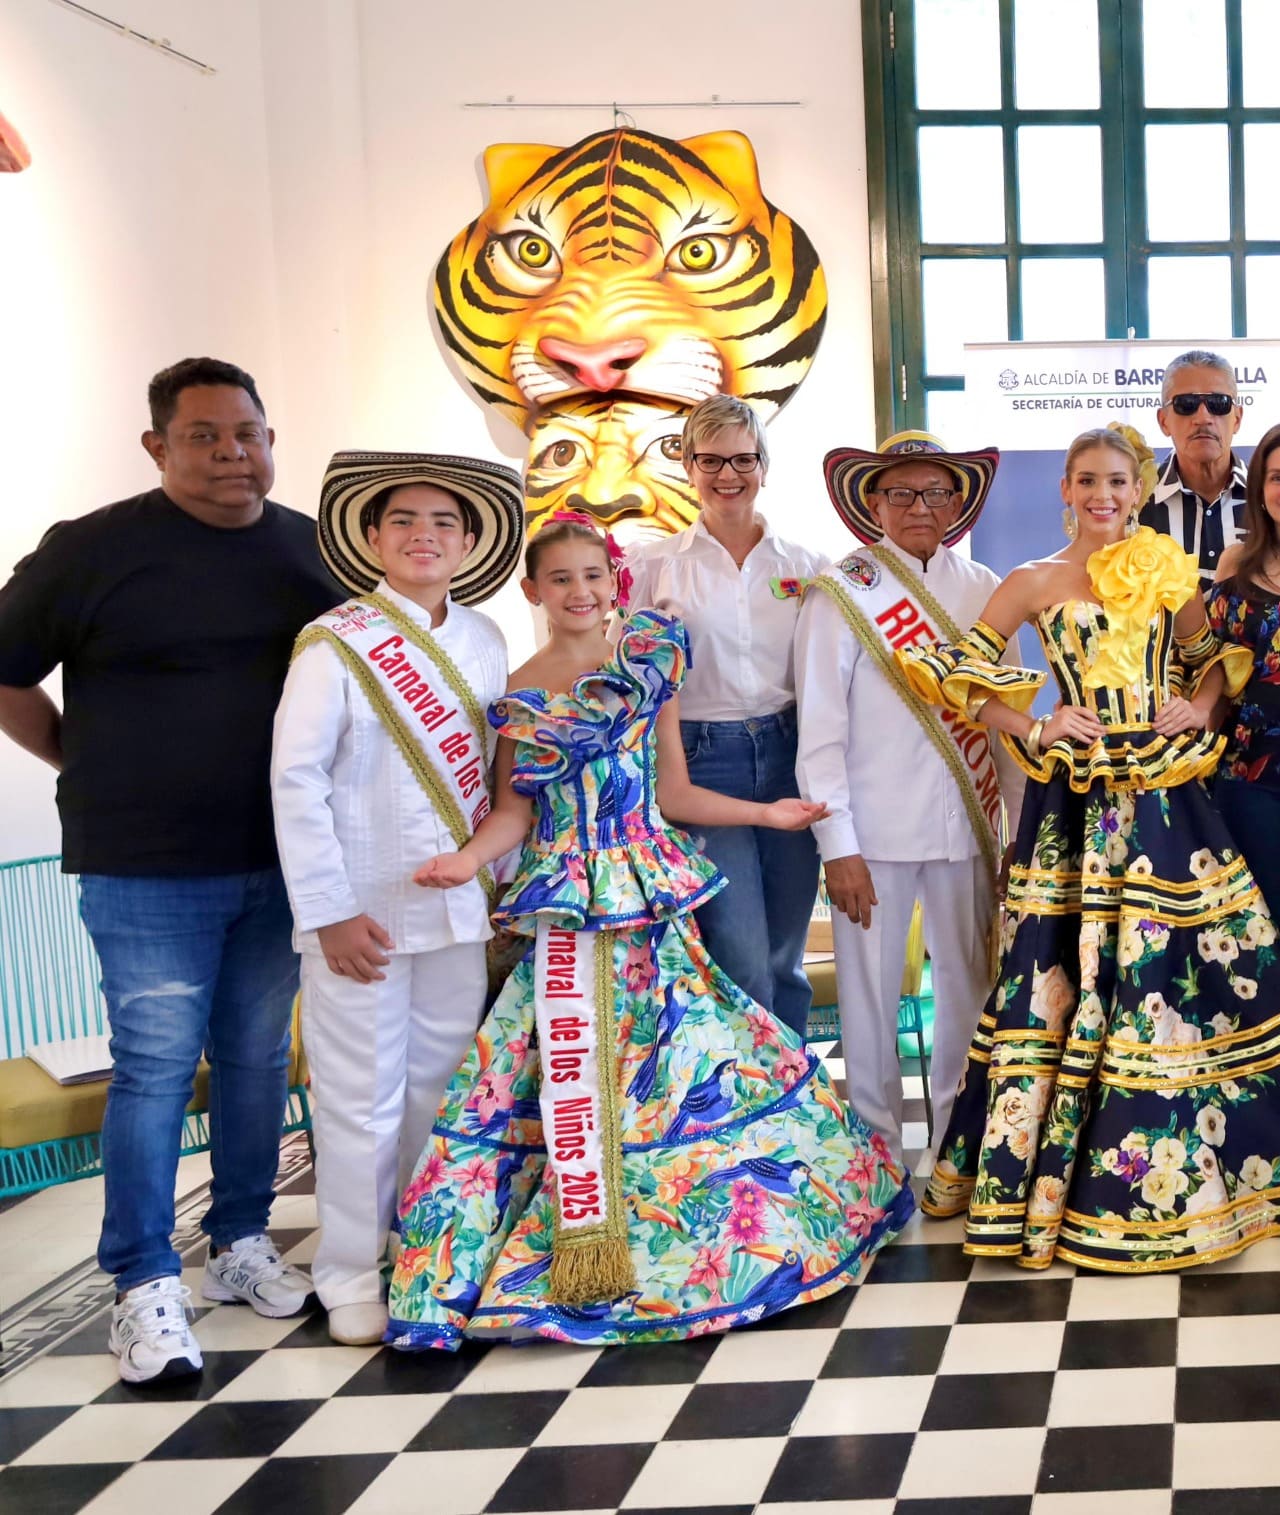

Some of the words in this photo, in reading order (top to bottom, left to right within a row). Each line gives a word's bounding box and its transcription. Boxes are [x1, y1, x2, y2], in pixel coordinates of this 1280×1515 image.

[1023, 370, 1088, 386] ALCALDÍA
[1092, 372, 1110, 385] DE
[1012, 396, 1083, 410] SECRETARÍA
[1087, 398, 1103, 409] DE
[1106, 397, 1162, 409] CULTURA
[875, 597, 941, 650] RE
[368, 635, 457, 732] Carnaval
[438, 732, 472, 764] de
[454, 757, 480, 799] los
[545, 924, 584, 998] rnaval
[550, 1016, 589, 1042] de
[550, 1048, 590, 1083] los
[553, 1096, 594, 1161] Niños
[562, 1171, 601, 1220] 2025
